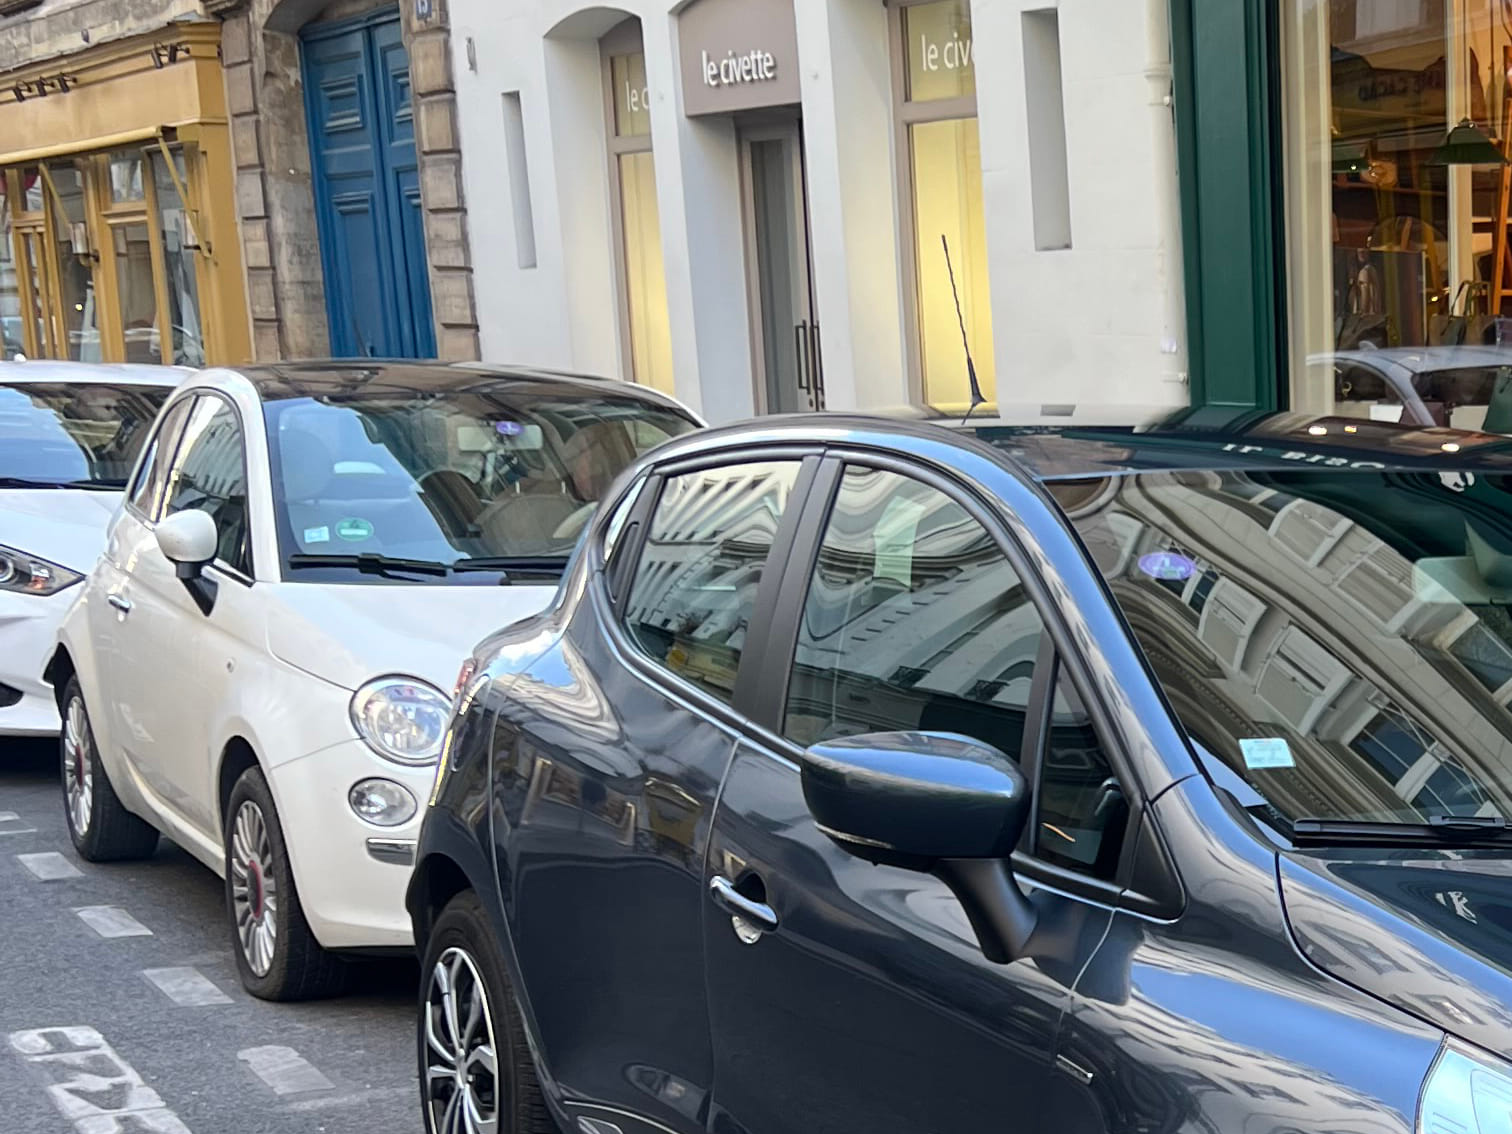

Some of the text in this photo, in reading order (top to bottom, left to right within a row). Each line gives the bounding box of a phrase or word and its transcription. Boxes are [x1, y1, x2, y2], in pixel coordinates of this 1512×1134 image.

[701, 49, 776, 87] le civette
[921, 31, 971, 72] le civ
[625, 81, 639, 113] le
